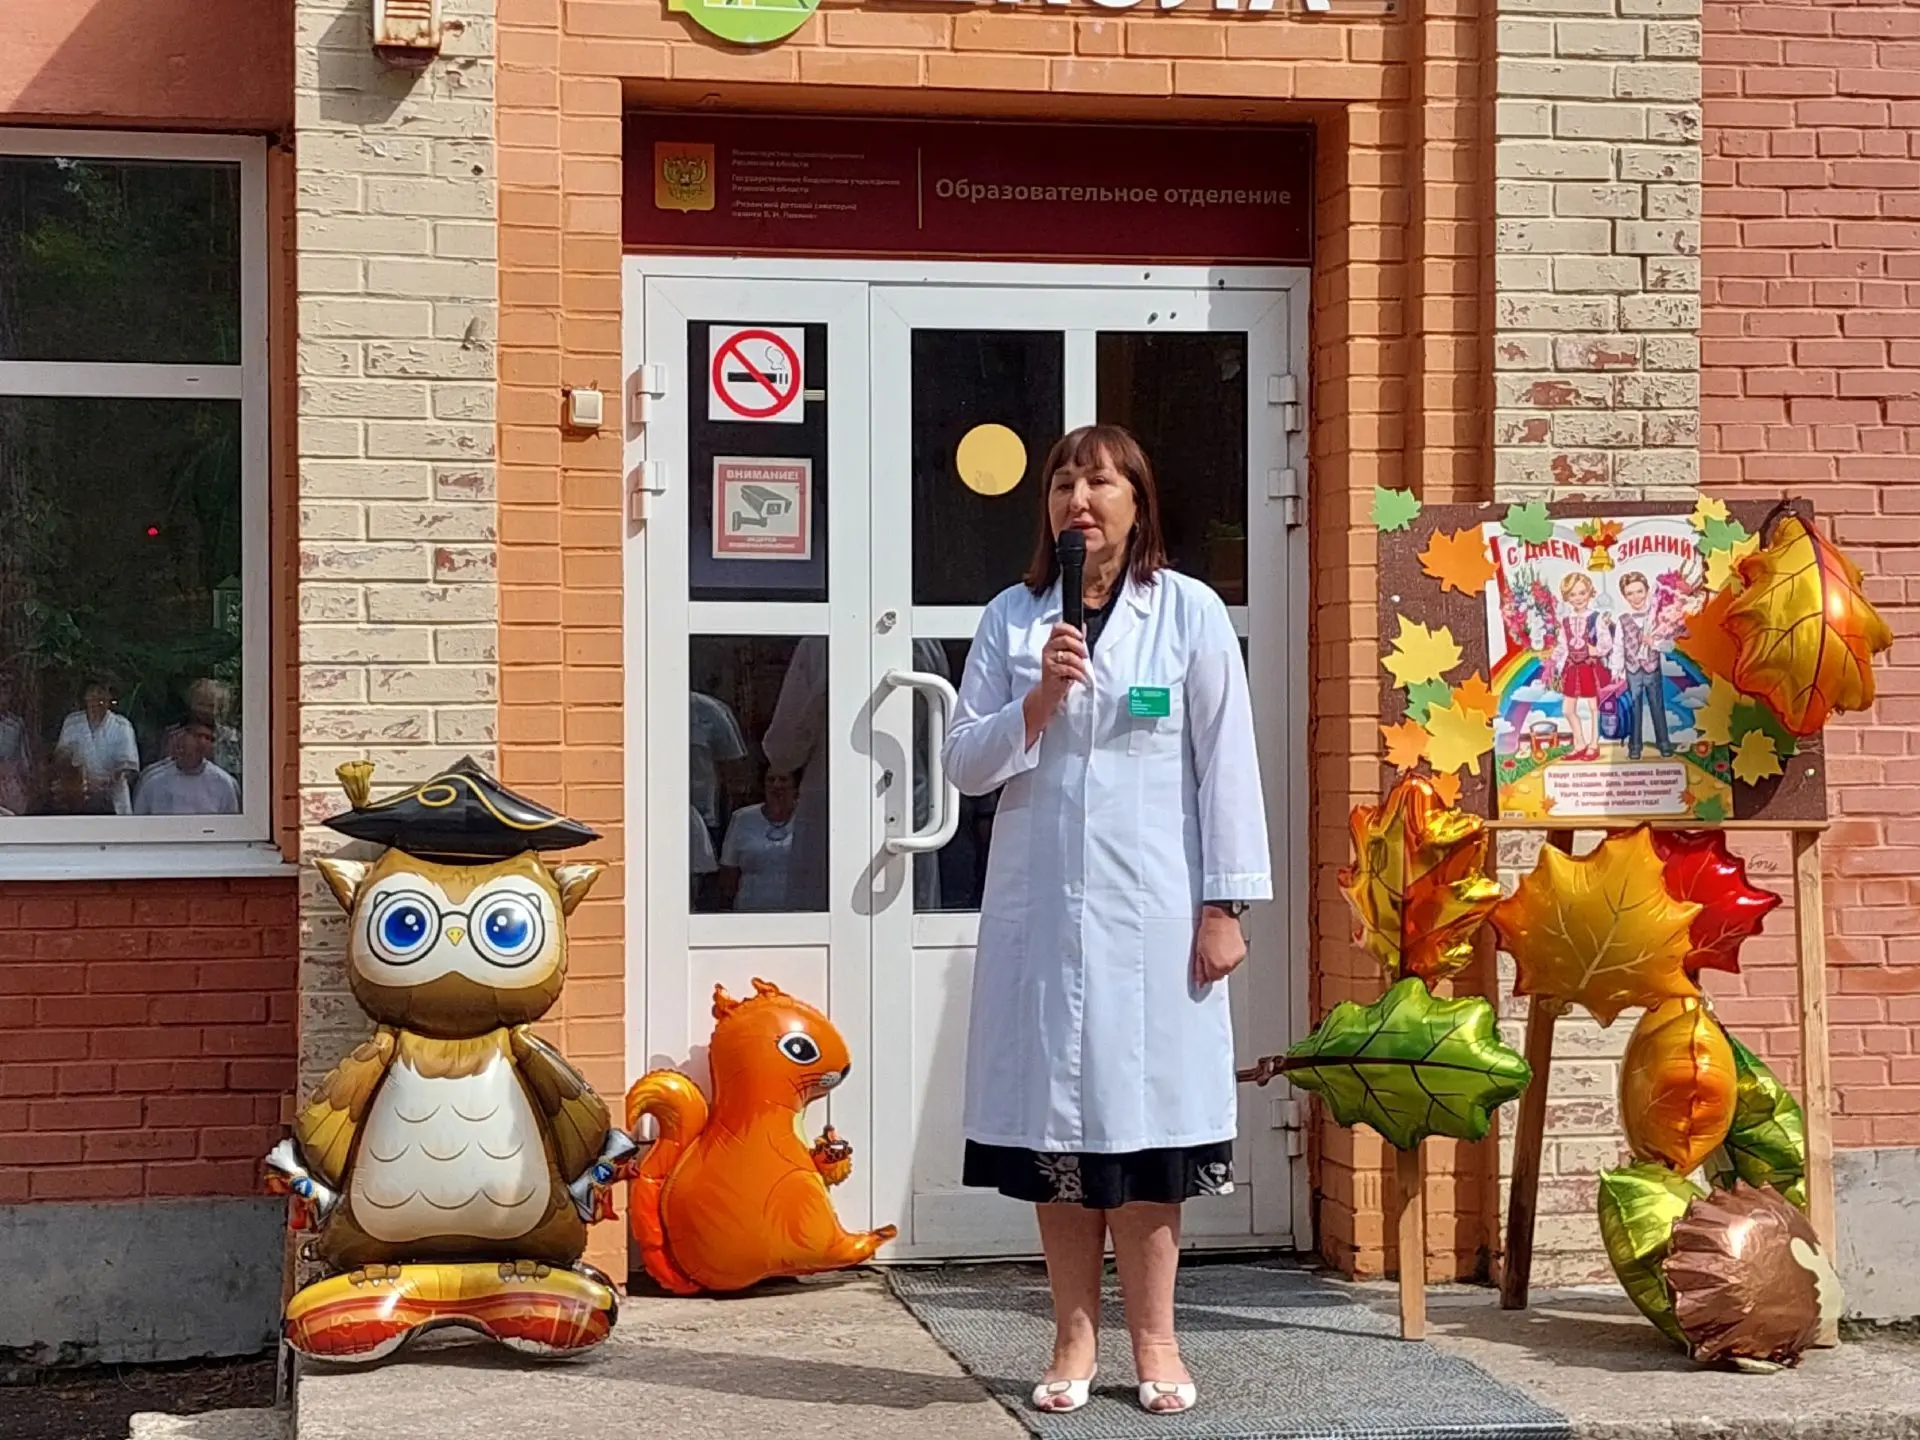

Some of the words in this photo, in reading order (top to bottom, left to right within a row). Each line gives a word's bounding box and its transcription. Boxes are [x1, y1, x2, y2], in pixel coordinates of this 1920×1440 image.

[935, 178, 1158, 204] Образовательное
[1163, 187, 1292, 208] отделение
[726, 468, 799, 481] ВНИМАНИЕ!
[1506, 546, 1518, 565] С
